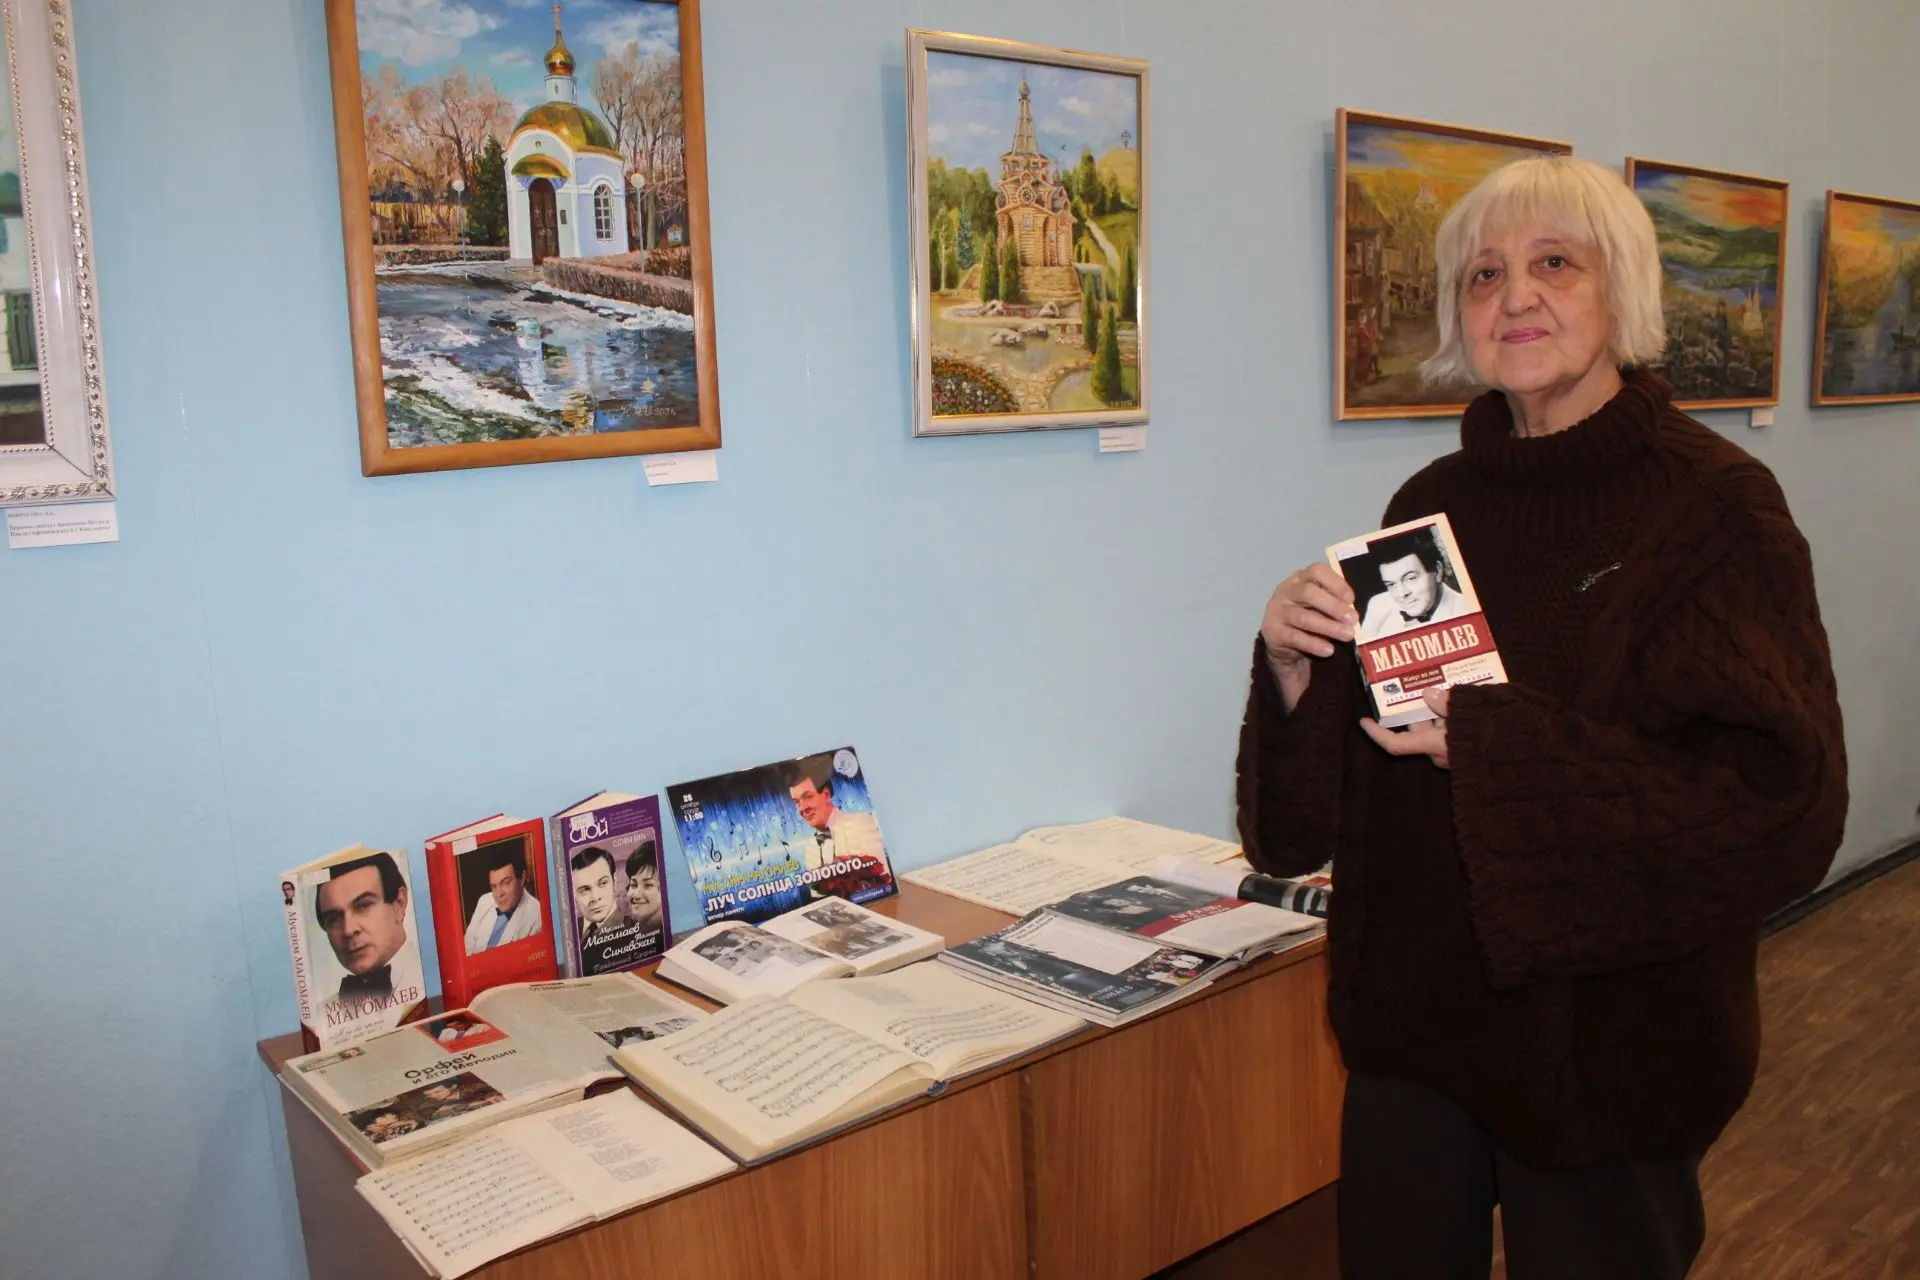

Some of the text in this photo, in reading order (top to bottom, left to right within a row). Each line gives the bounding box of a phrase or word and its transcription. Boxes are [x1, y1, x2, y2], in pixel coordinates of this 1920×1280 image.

[1369, 623, 1480, 673] МАГОМАЕВ
[684, 811, 704, 822] 11:00
[737, 877, 794, 903] СОЛНЦА
[583, 922, 640, 951] Магомаев
[602, 938, 656, 961] Синявская
[293, 953, 312, 1021] МАГОМАЕВ
[327, 986, 419, 1028] МАГОМАЕВ
[404, 1052, 478, 1079] Орфей
[453, 1048, 518, 1071] Мелодия
